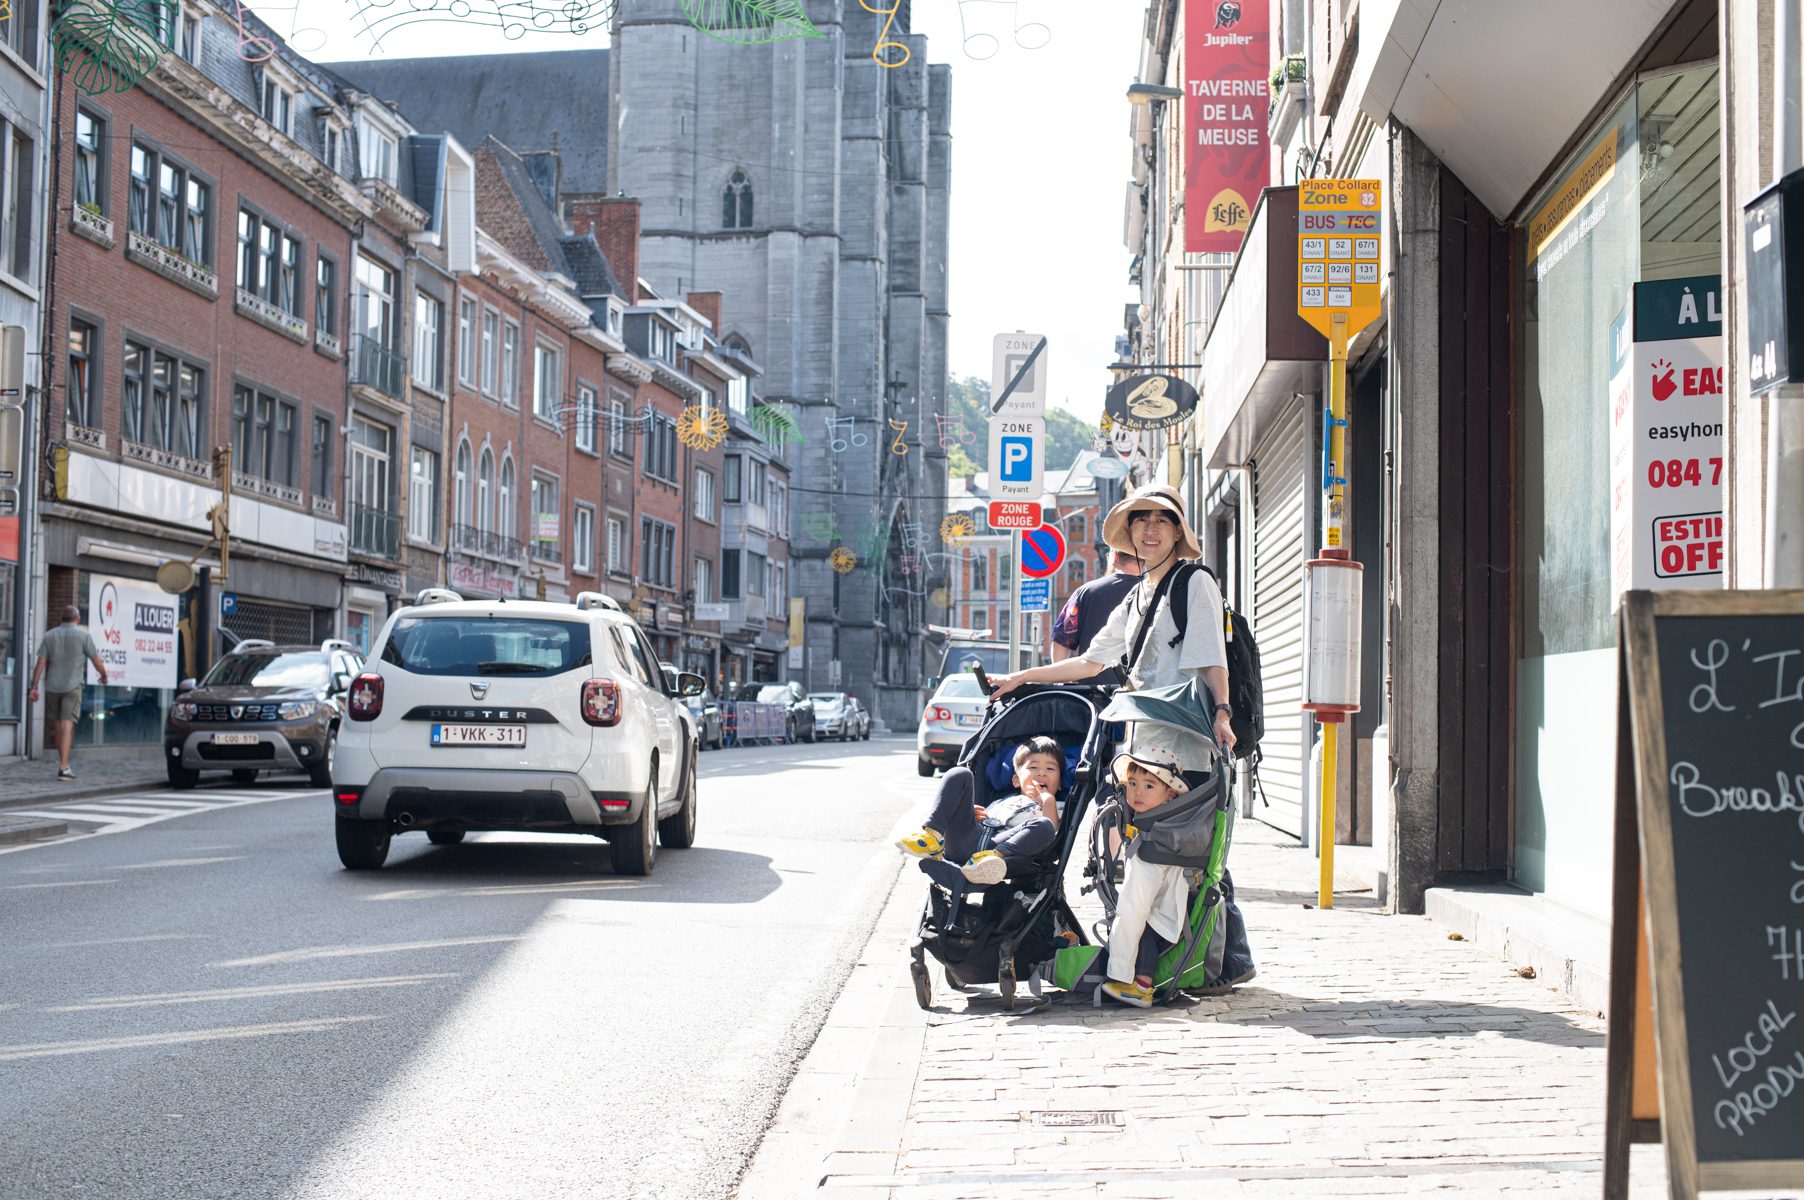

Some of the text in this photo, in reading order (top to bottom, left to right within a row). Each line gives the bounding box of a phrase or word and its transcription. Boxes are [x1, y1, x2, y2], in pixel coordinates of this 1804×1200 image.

[1203, 33, 1253, 47] Jupiler
[1189, 80, 1267, 96] TAVERNE
[1203, 104, 1254, 121] DE LA
[1198, 129, 1259, 145] MEUSE
[1302, 180, 1380, 190] Place Collard
[1304, 191, 1375, 205] Zone 32
[1213, 202, 1245, 227] Leffe
[1304, 215, 1376, 229] BUS TEC
[1305, 241, 1322, 249] 43/1
[1335, 241, 1346, 249] 52
[1358, 241, 1375, 249] 67/1
[1304, 265, 1322, 273] 67/2
[1330, 265, 1350, 273] 92/6
[1360, 265, 1373, 273] 131
[1678, 286, 1699, 325] À
[1006, 341, 1036, 350] ZONE
[1126, 419, 1142, 428] Roi
[1145, 420, 1161, 428] des
[1163, 408, 1193, 427] Moules
[1002, 424, 1032, 432] ZONE
[1005, 443, 1028, 475] P
[1648, 459, 1701, 488] 084
[1002, 485, 1029, 494] Payant
[1001, 504, 1029, 514] ZONE
[998, 516, 1033, 526] ROUGE
[135, 606, 173, 629] A LOUER
[430, 711, 527, 719] DUSTER
[1711, 999, 1796, 1089] LOCAL
